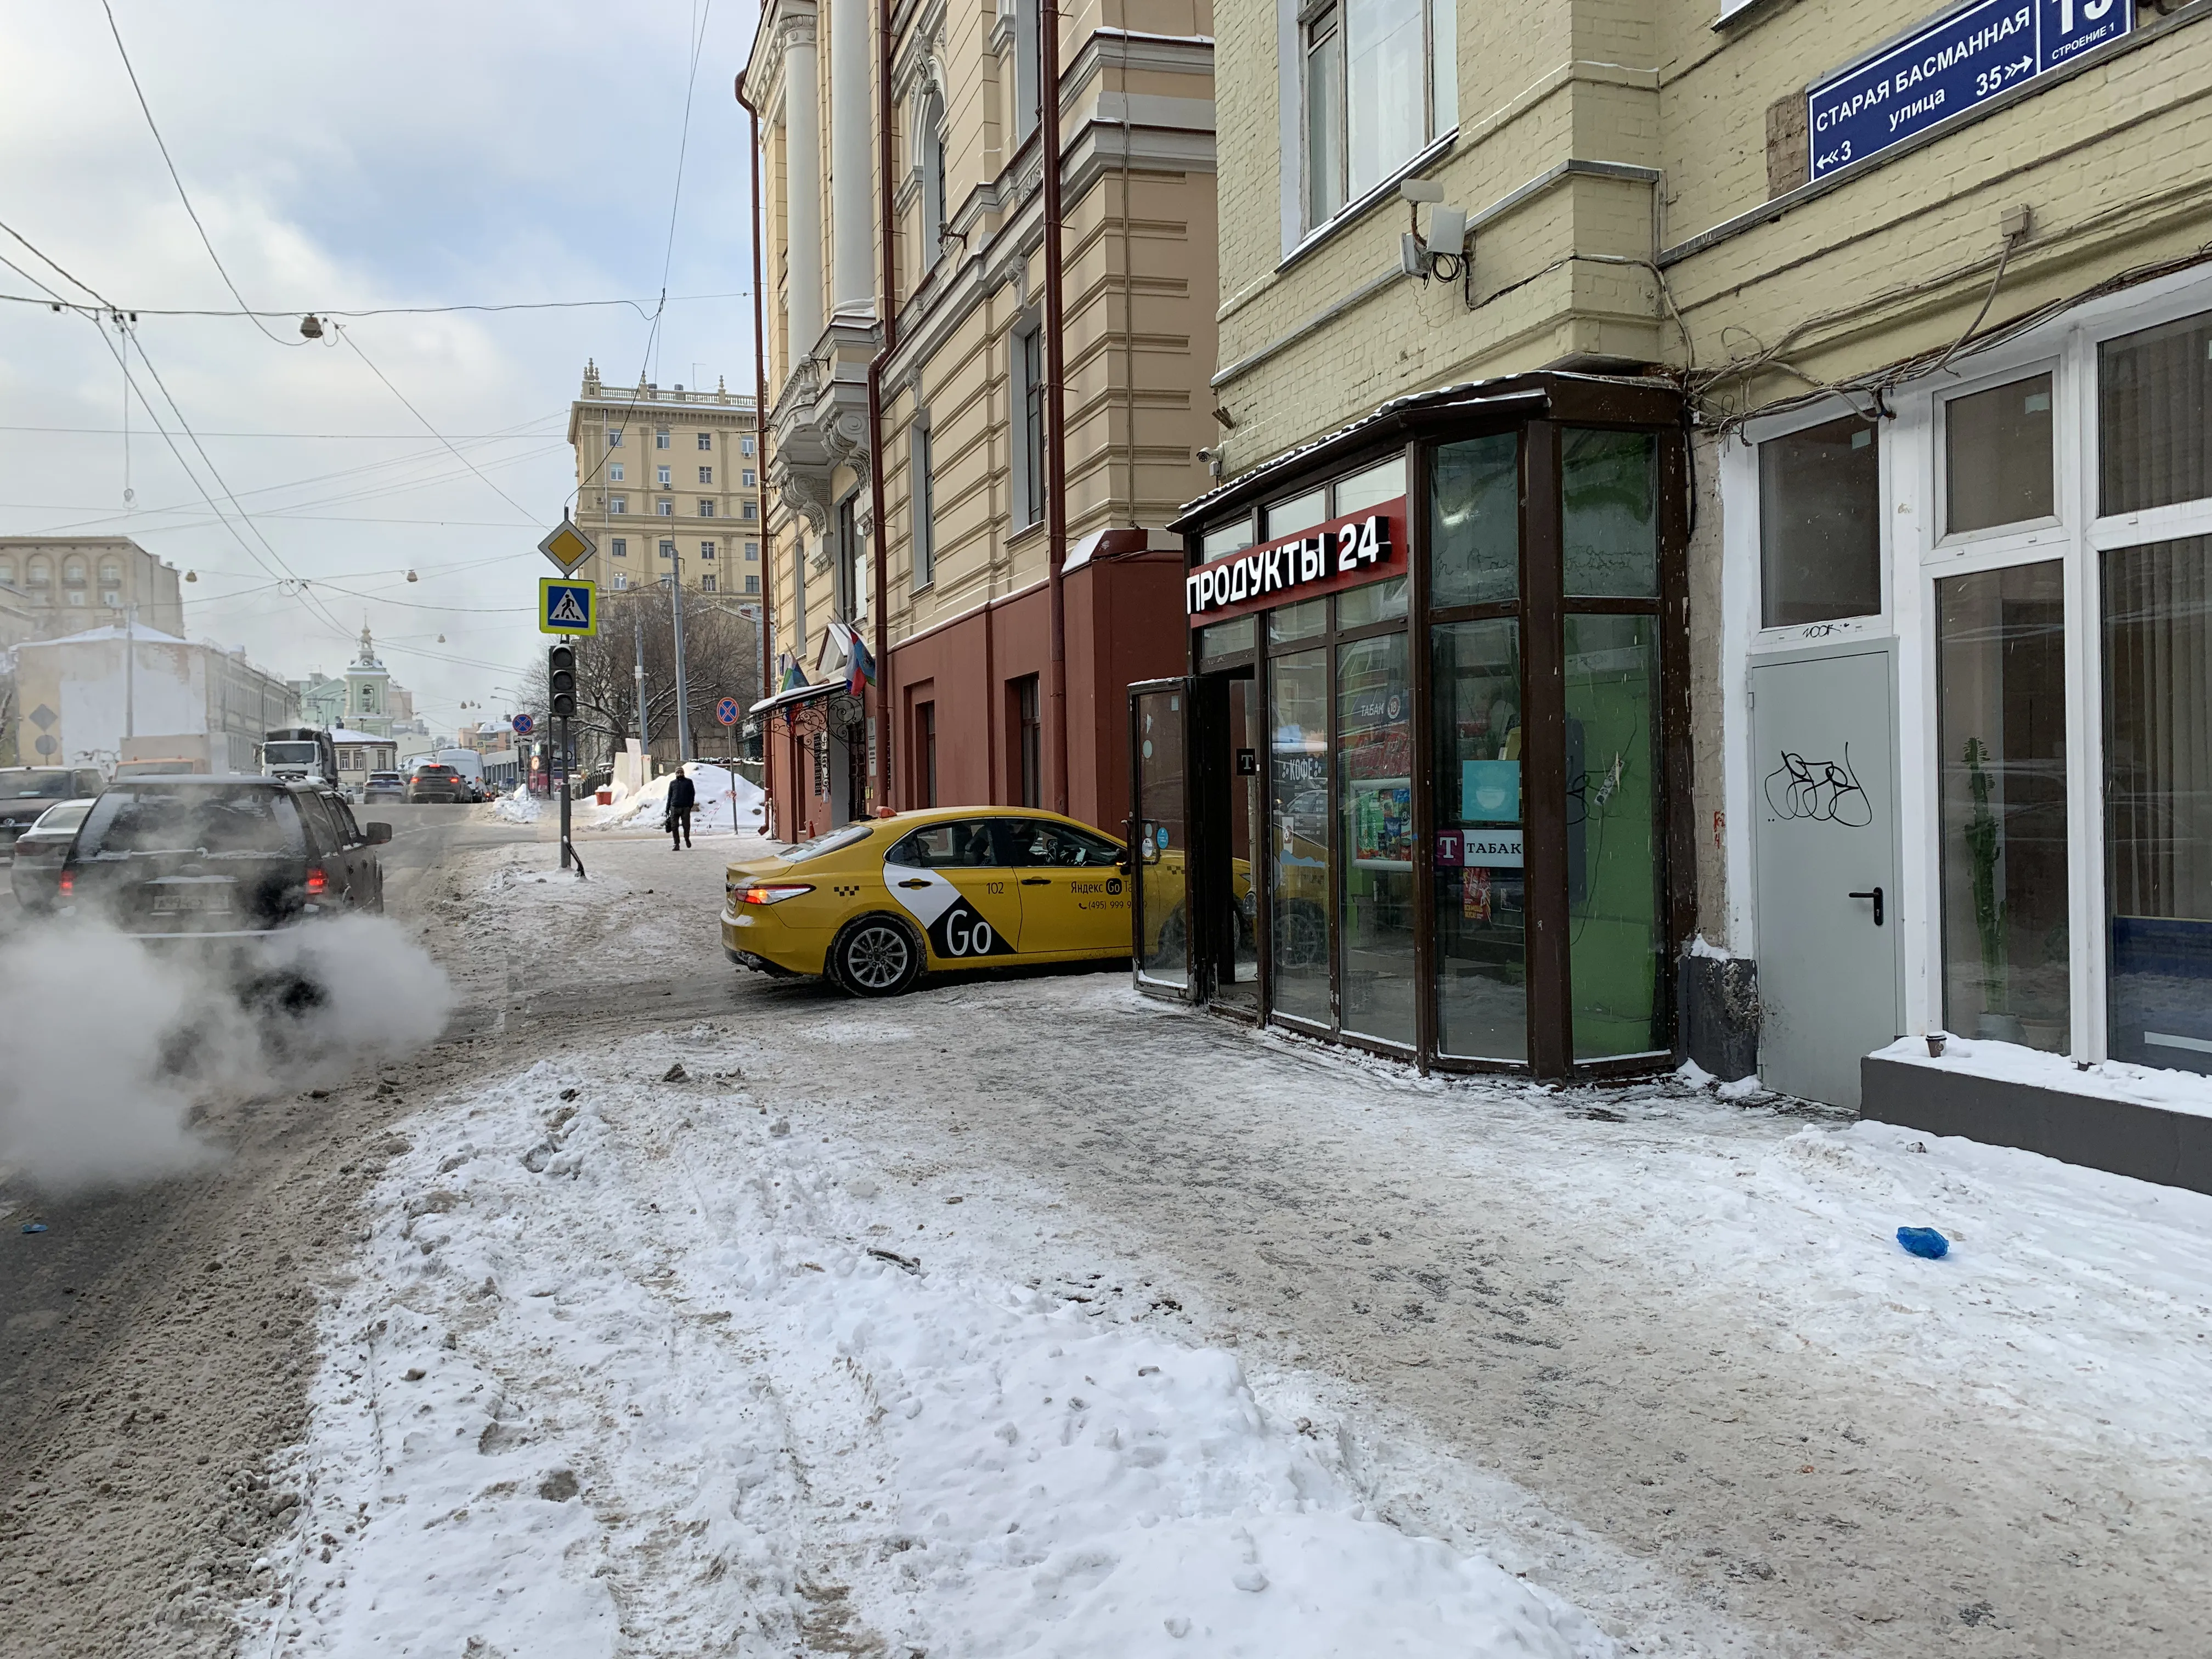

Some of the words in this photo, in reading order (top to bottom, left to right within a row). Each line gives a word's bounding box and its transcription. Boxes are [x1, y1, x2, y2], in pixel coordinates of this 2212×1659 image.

[2052, 26, 2107, 60] СТРОЕНИЕ
[2109, 22, 2114, 32] 1
[1816, 80, 1889, 132] СТАРАЯ
[1895, 6, 2030, 93] БАСМАННАЯ
[1976, 65, 2001, 96] 35
[1889, 88, 1945, 132] улица
[1841, 140, 1852, 161] 3
[1187, 532, 1325, 614] ПРОДУКТЫ
[1339, 515, 1379, 572] 24
[1361, 702, 1385, 716] ТАБАК
[1290, 758, 1313, 781] КОФЕ
[1466, 843, 1522, 854] ТАБАК
[986, 882, 1004, 894] 102
[1071, 881, 1103, 894] Яндекс
[1107, 880, 1120, 893] Go
[1088, 901, 1107, 911] (495)
[1110, 900, 1124, 909] 999
[946, 909, 992, 956] Go
